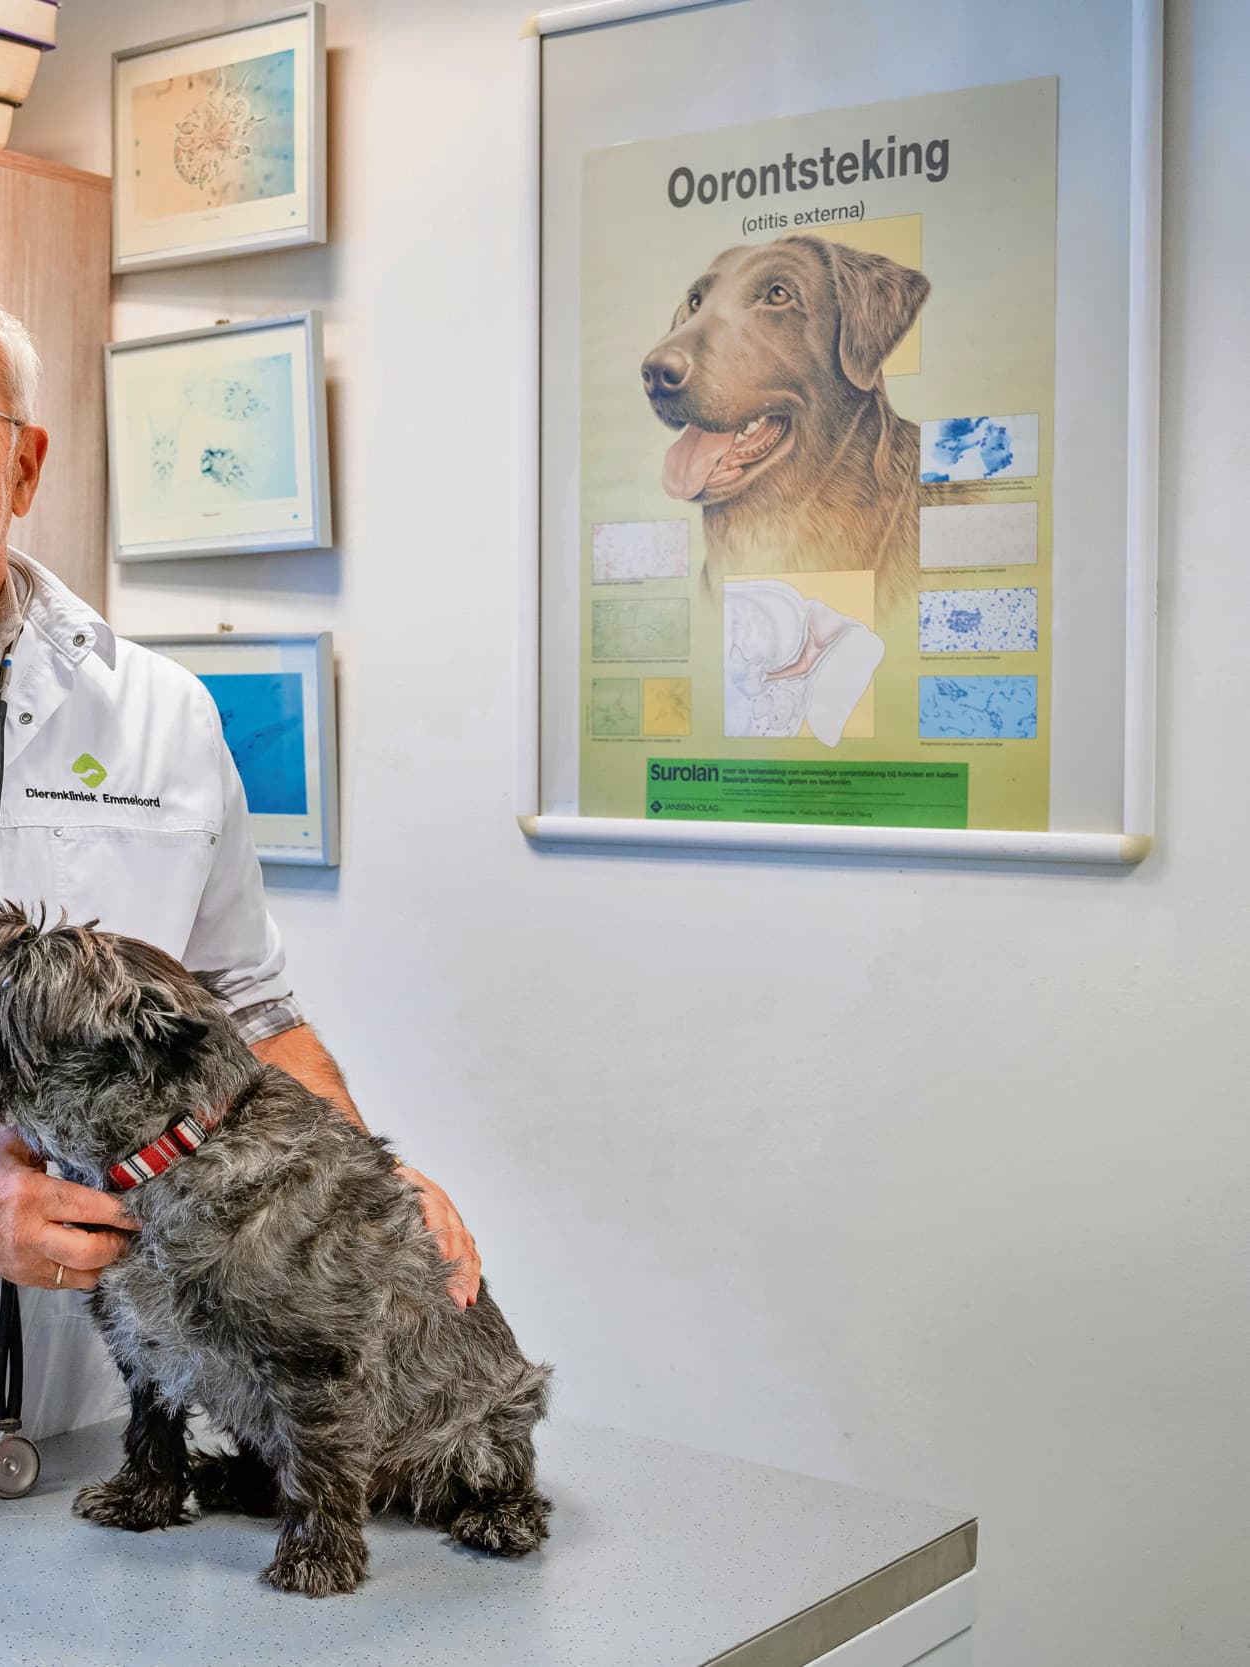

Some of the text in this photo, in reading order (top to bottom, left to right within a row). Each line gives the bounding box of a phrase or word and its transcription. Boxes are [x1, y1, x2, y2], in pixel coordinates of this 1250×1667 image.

[667, 135, 949, 208] Oorontsteking
[742, 200, 865, 236] (otitis externa)
[651, 764, 718, 782] Surolan
[25, 788, 161, 808] Dierenkliniek Emmeloord
